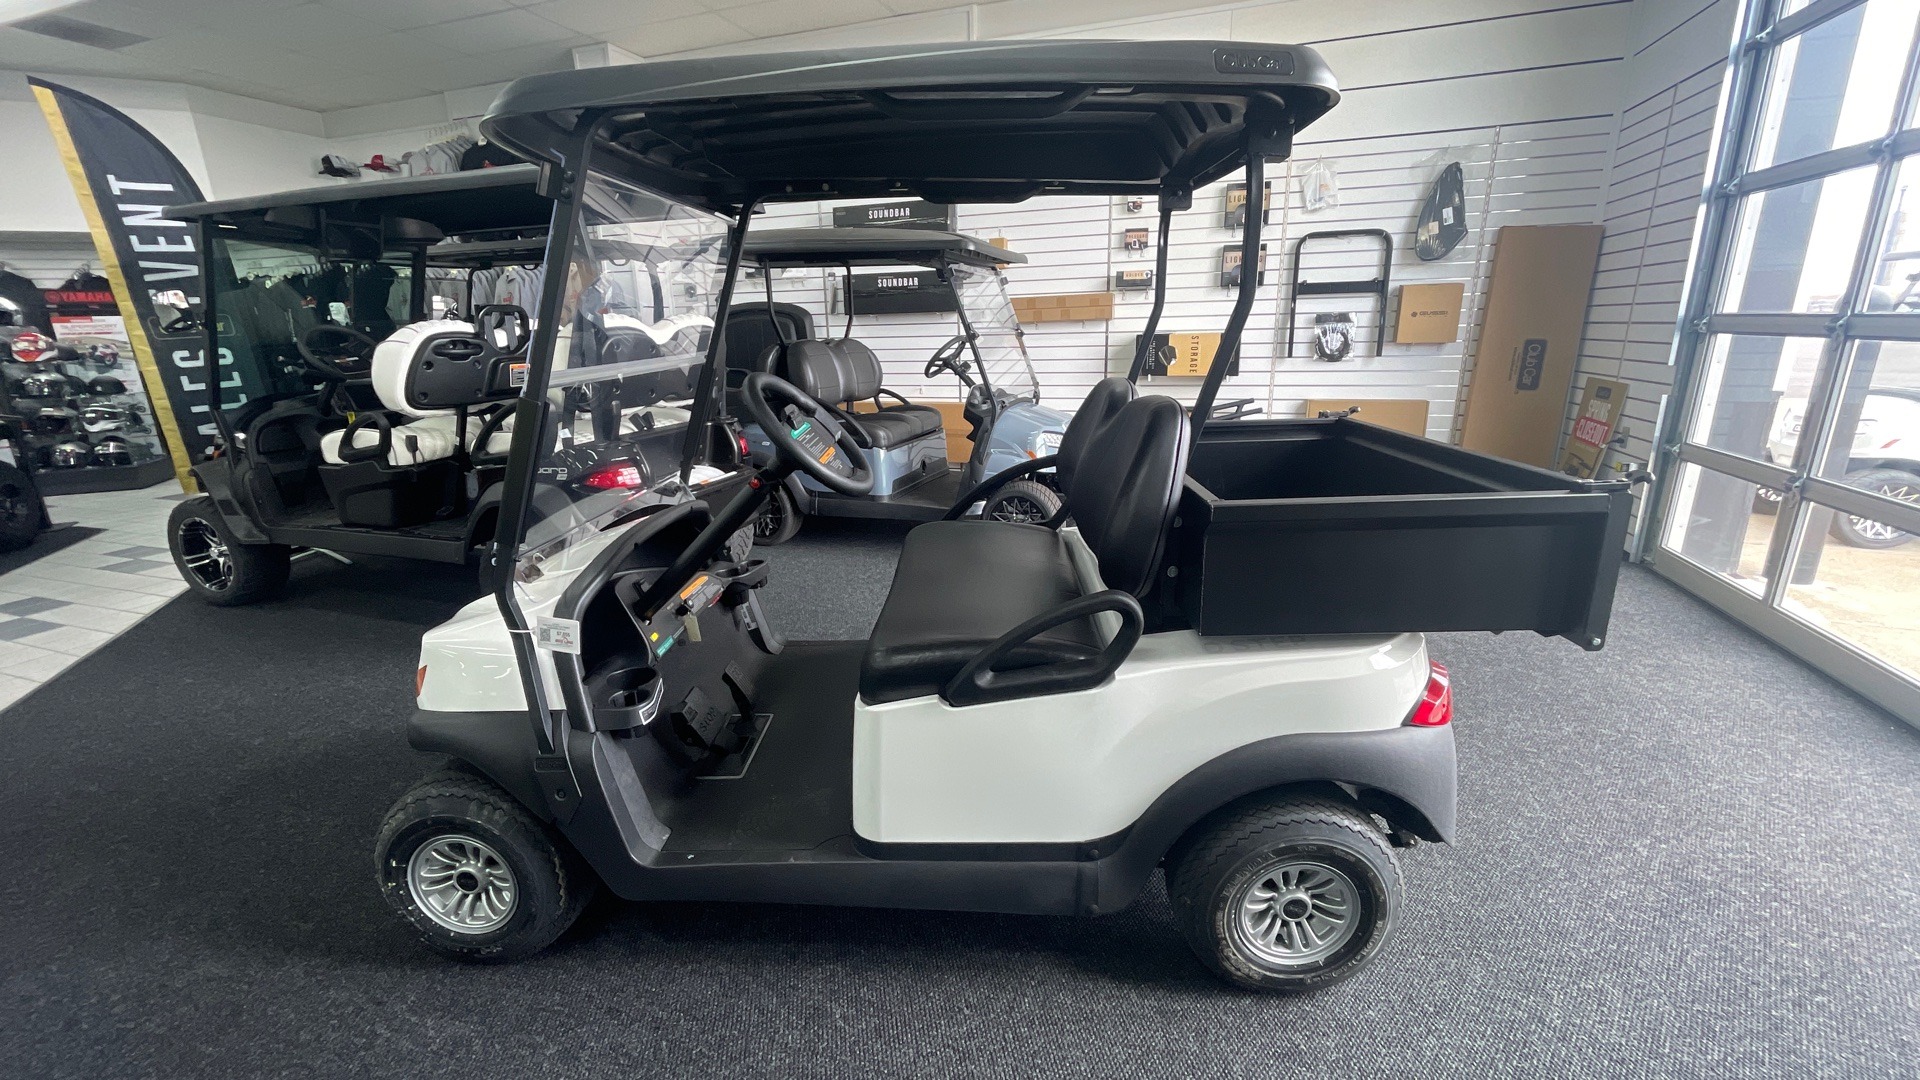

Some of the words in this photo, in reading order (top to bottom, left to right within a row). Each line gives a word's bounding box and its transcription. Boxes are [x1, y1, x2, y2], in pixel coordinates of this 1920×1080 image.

[868, 207, 911, 219] SOUNDBAR
[107, 174, 201, 304] VENT
[877, 277, 919, 288] SOUNDBAR
[60, 291, 114, 302] YAMAHA
[1189, 335, 1200, 373] STORAGE
[1525, 344, 1541, 367] Club
[1522, 368, 1537, 386] Car
[172, 349, 248, 455] ALES
[1576, 418, 1609, 446] CLOSEOUT
